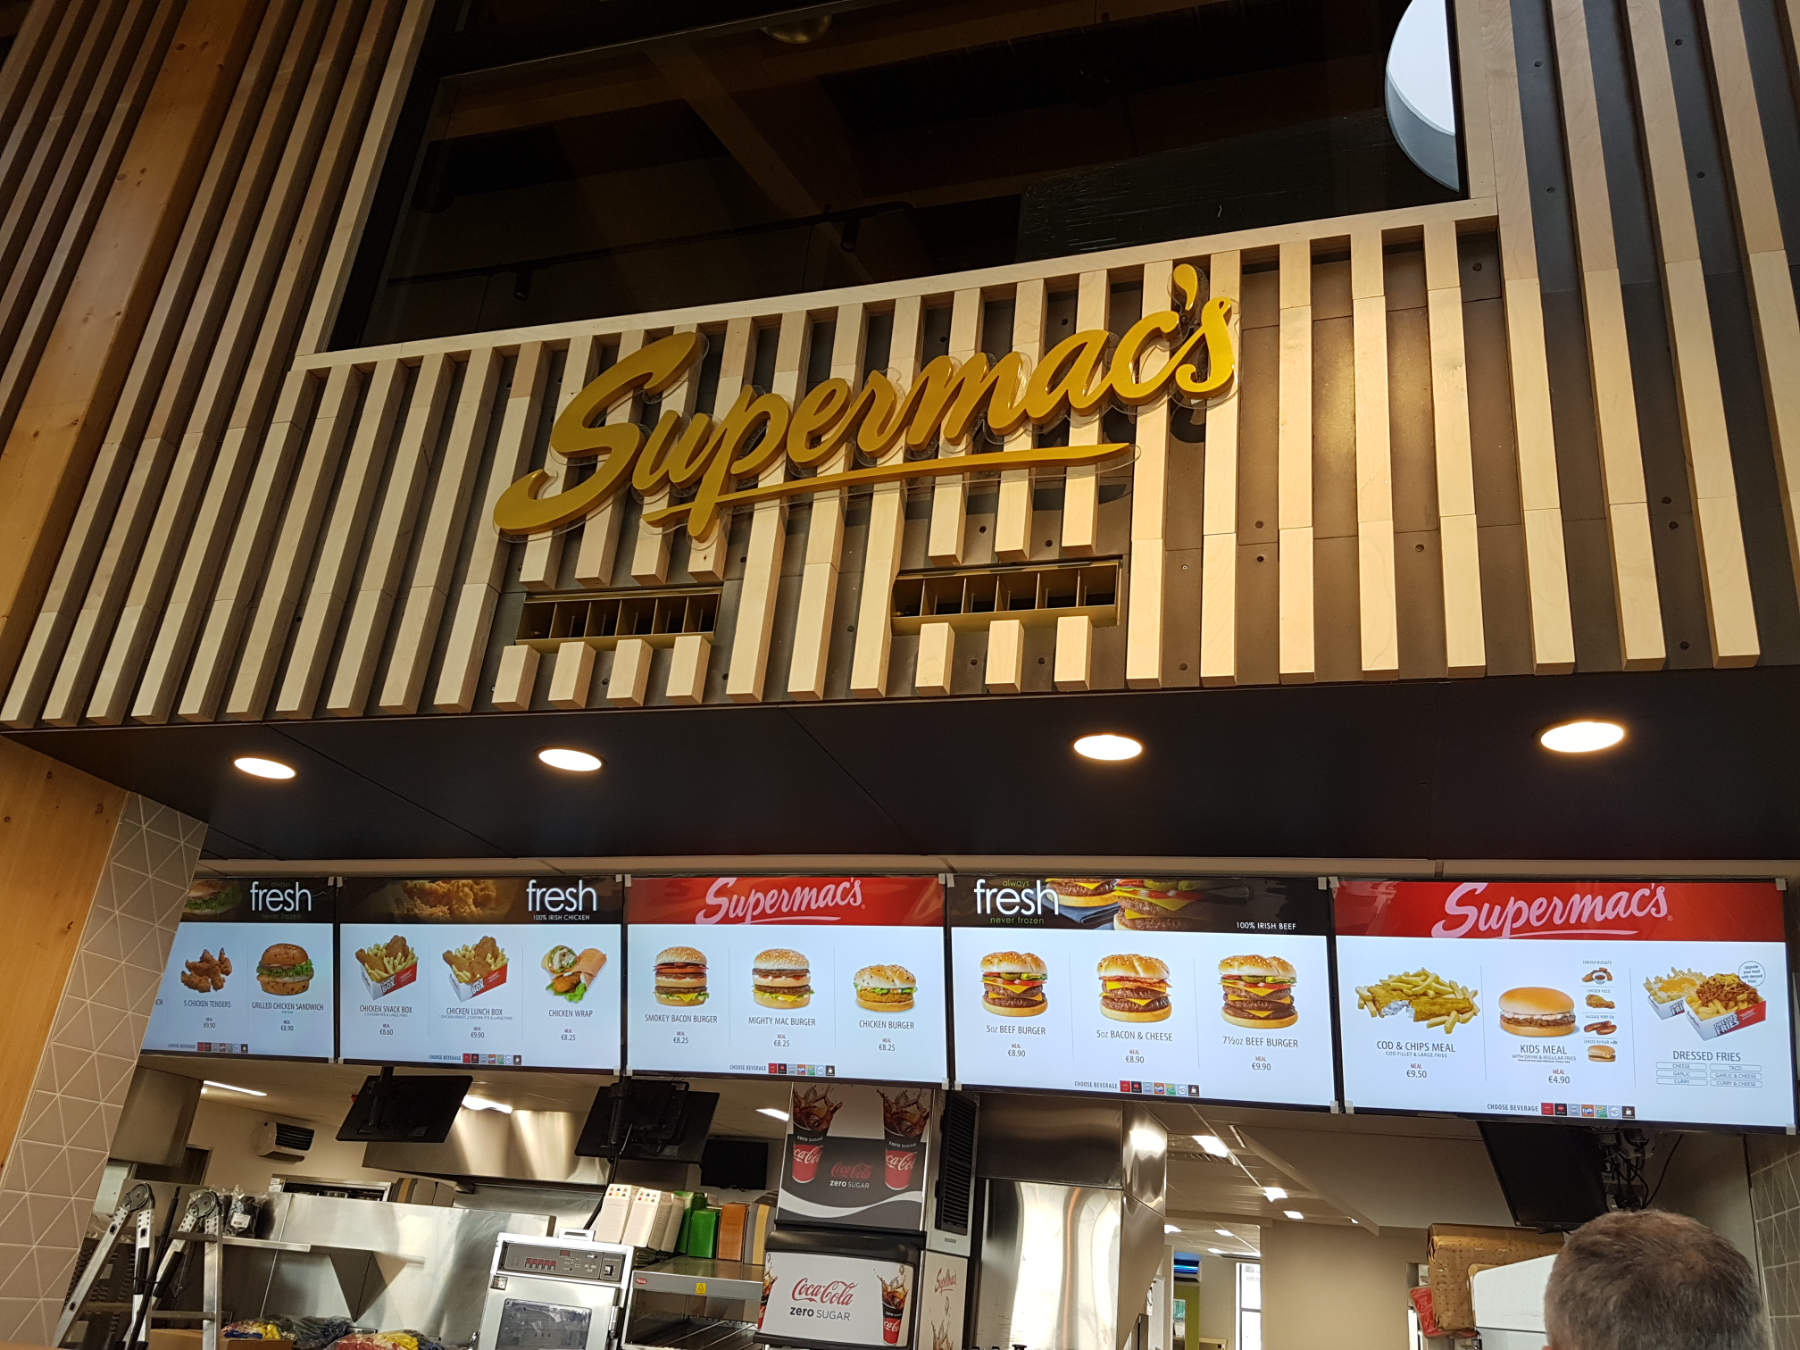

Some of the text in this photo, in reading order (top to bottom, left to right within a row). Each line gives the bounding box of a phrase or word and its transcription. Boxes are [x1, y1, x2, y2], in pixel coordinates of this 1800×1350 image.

[493, 264, 1234, 541] Supermac's
[1003, 880, 1030, 888] always
[250, 881, 312, 912] fresh
[526, 879, 597, 912] fresh
[974, 879, 1059, 915] fresh
[695, 877, 863, 925] Supermac's
[1431, 882, 1668, 939] Supermac's
[1236, 921, 1297, 930] 100% IRISH BEEF
[446, 1007, 470, 1015] CHICKEN
[491, 1008, 503, 1016] BOX
[548, 1009, 573, 1017] CHICKEN
[644, 1014, 718, 1024] SMOKEY BACON BURGER
[748, 1016, 816, 1026] MIGHTY MAC BURGER
[859, 1019, 915, 1030] CHICKEN BURGER
[986, 1025, 1046, 1035] 5oz BEEF BURGER
[673, 1036, 689, 1044] €8.25
[1096, 1029, 1173, 1042] 5oz BACON & CHEESE
[1245, 1037, 1264, 1046] BEEF
[1266, 1038, 1299, 1048] BURGER
[1376, 1040, 1456, 1053] COD & CHIPS MEAL
[1008, 1049, 1026, 1058] €8.90
[1520, 1044, 1568, 1055] KIDS MEAL
[1125, 1055, 1145, 1064] €8.90
[1672, 1050, 1741, 1062] DRESSED FRIES
[1251, 1062, 1272, 1071] €9.90
[1406, 1069, 1428, 1079] €9.50
[1548, 1075, 1571, 1084] €4.90
[1487, 1103, 1539, 1112] CHOOSE BEVERAGE
[829, 1180, 870, 1189] zero SUGAR
[791, 1277, 857, 1306] Coca-Cola
[789, 1306, 850, 1321] zero SUGAR
